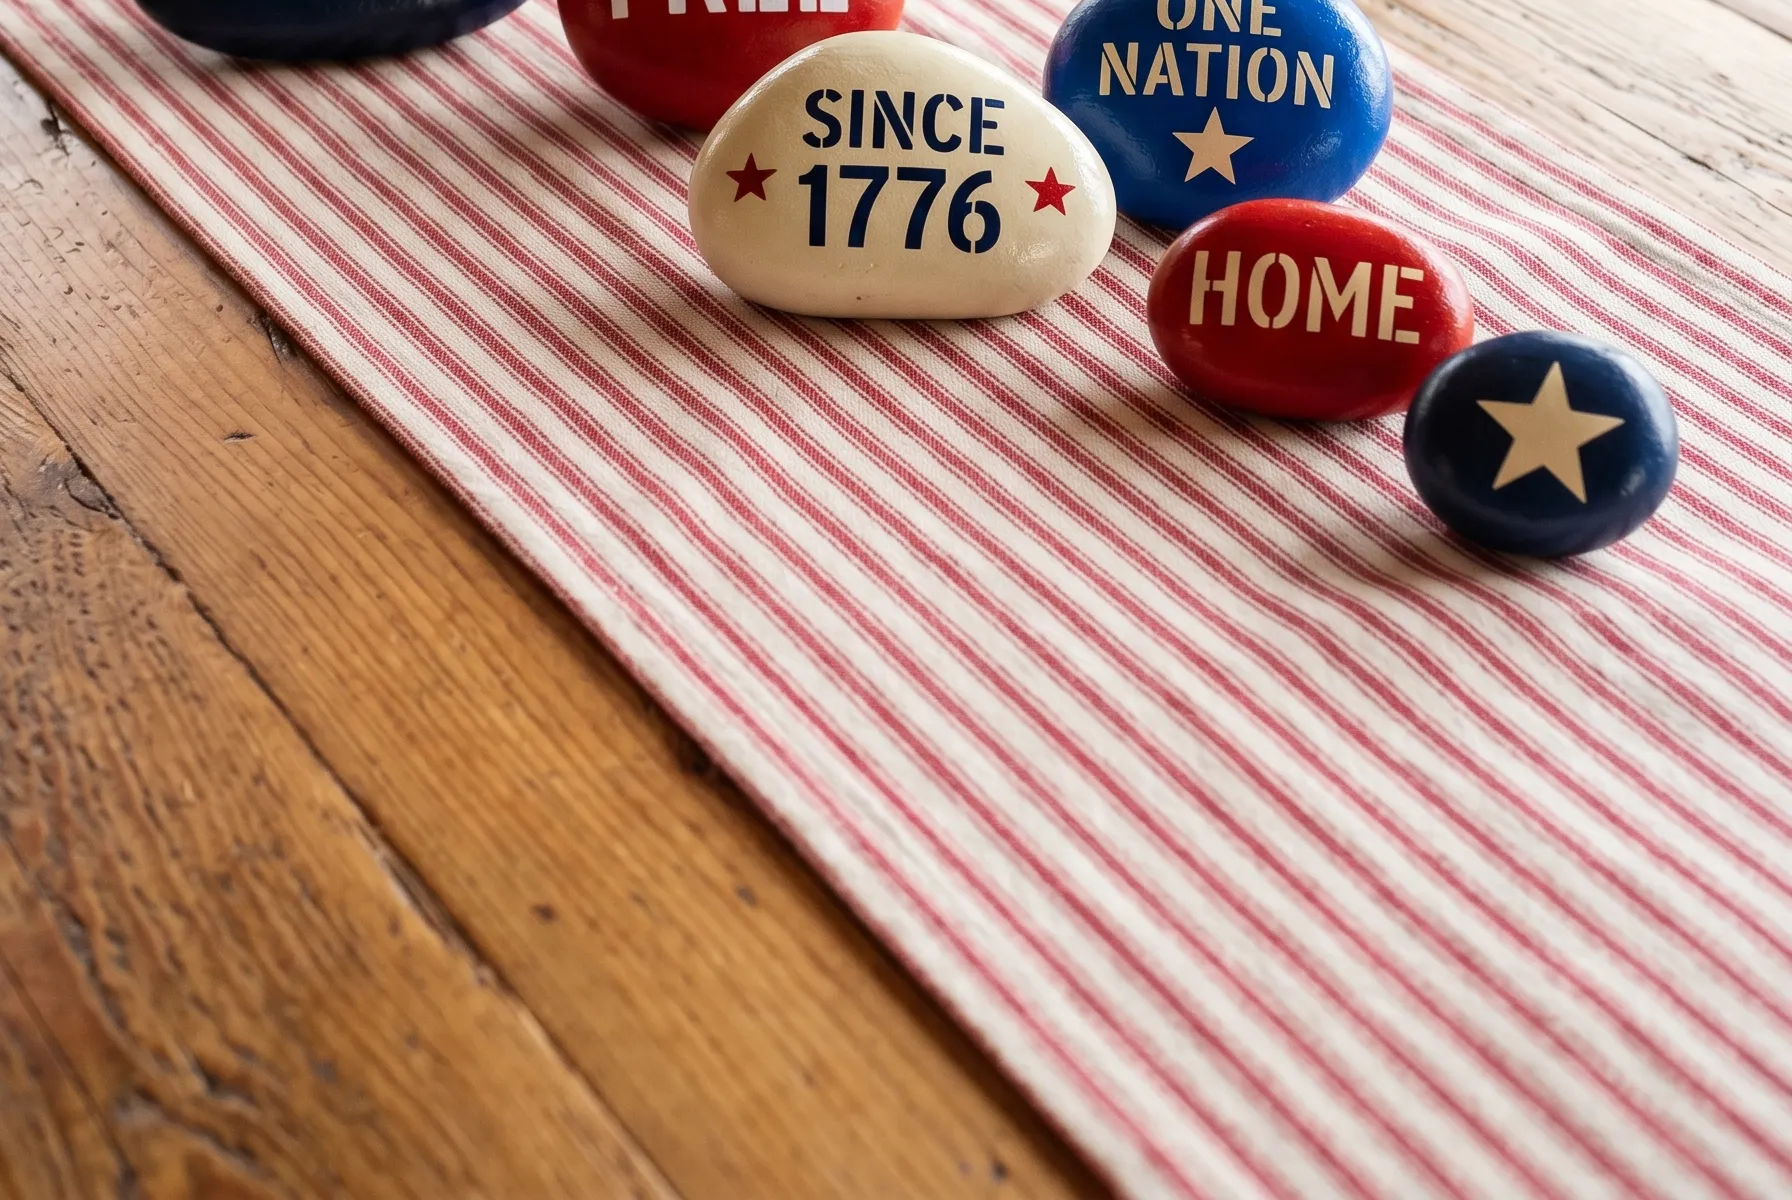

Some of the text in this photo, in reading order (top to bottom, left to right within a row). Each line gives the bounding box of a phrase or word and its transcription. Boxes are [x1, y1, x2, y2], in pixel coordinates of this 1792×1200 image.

[1098, 42, 1334, 109] NATION
[801, 88, 1006, 157] SINCE
[798, 164, 1001, 254] 1776
[1189, 249, 1424, 345] HOME
